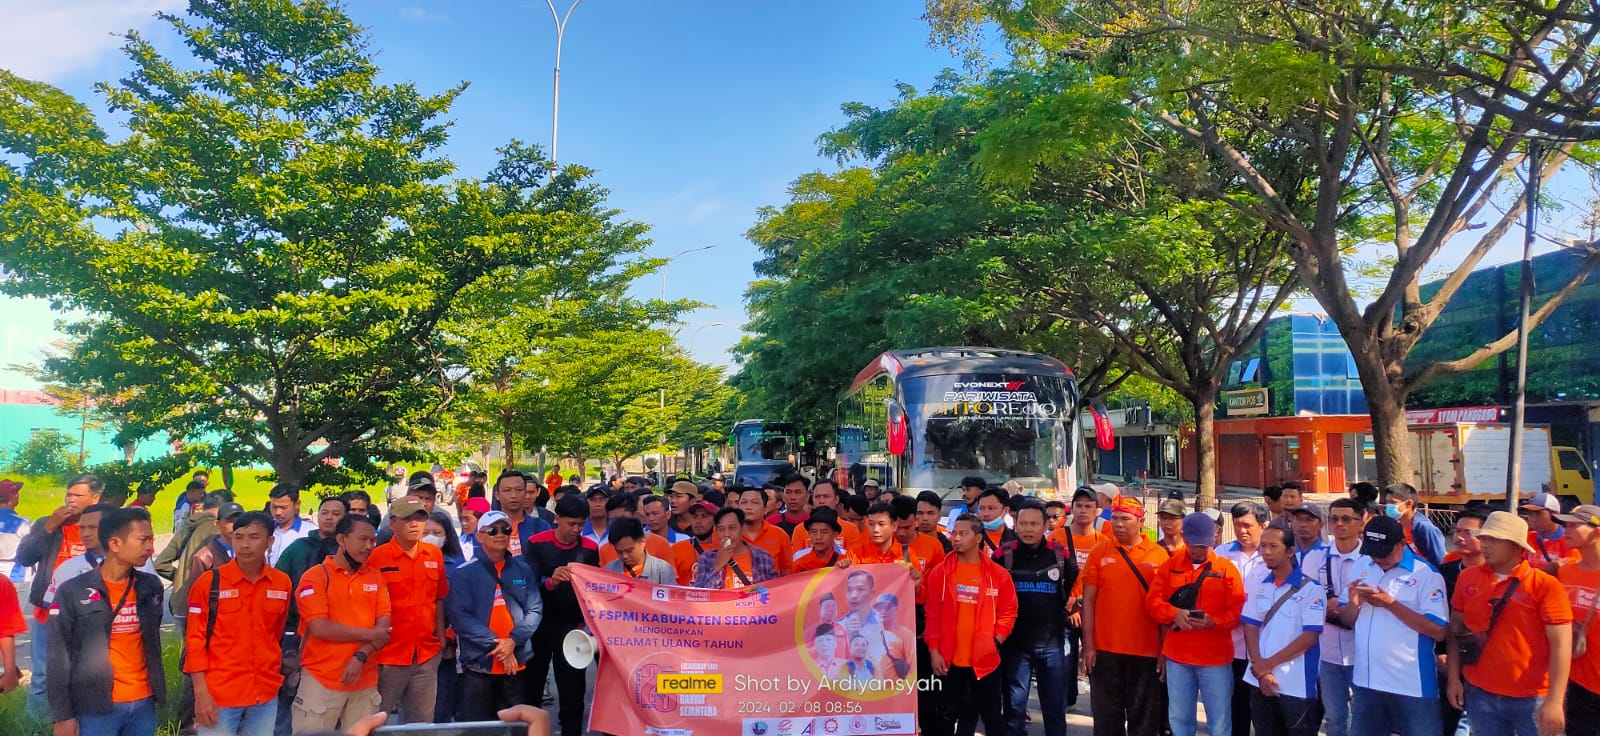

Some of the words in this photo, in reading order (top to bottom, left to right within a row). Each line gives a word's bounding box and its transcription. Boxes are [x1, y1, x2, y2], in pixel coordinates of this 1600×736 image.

[953, 381, 1009, 389] EVONEXT
[944, 391, 1038, 402] PARIWISATA
[1229, 396, 1246, 406] KANTOR
[1246, 395, 1256, 405] POS
[584, 581, 620, 593] FSPMI
[656, 589, 665, 599] 6
[599, 610, 639, 622] FSPMI
[641, 613, 722, 626] KABUPATEN
[724, 615, 778, 625] SERANG
[634, 626, 704, 636] MENGUCAPKAN
[606, 637, 658, 648] SELAMAT
[662, 639, 700, 649] ULANG
[704, 639, 744, 649] TAHUN
